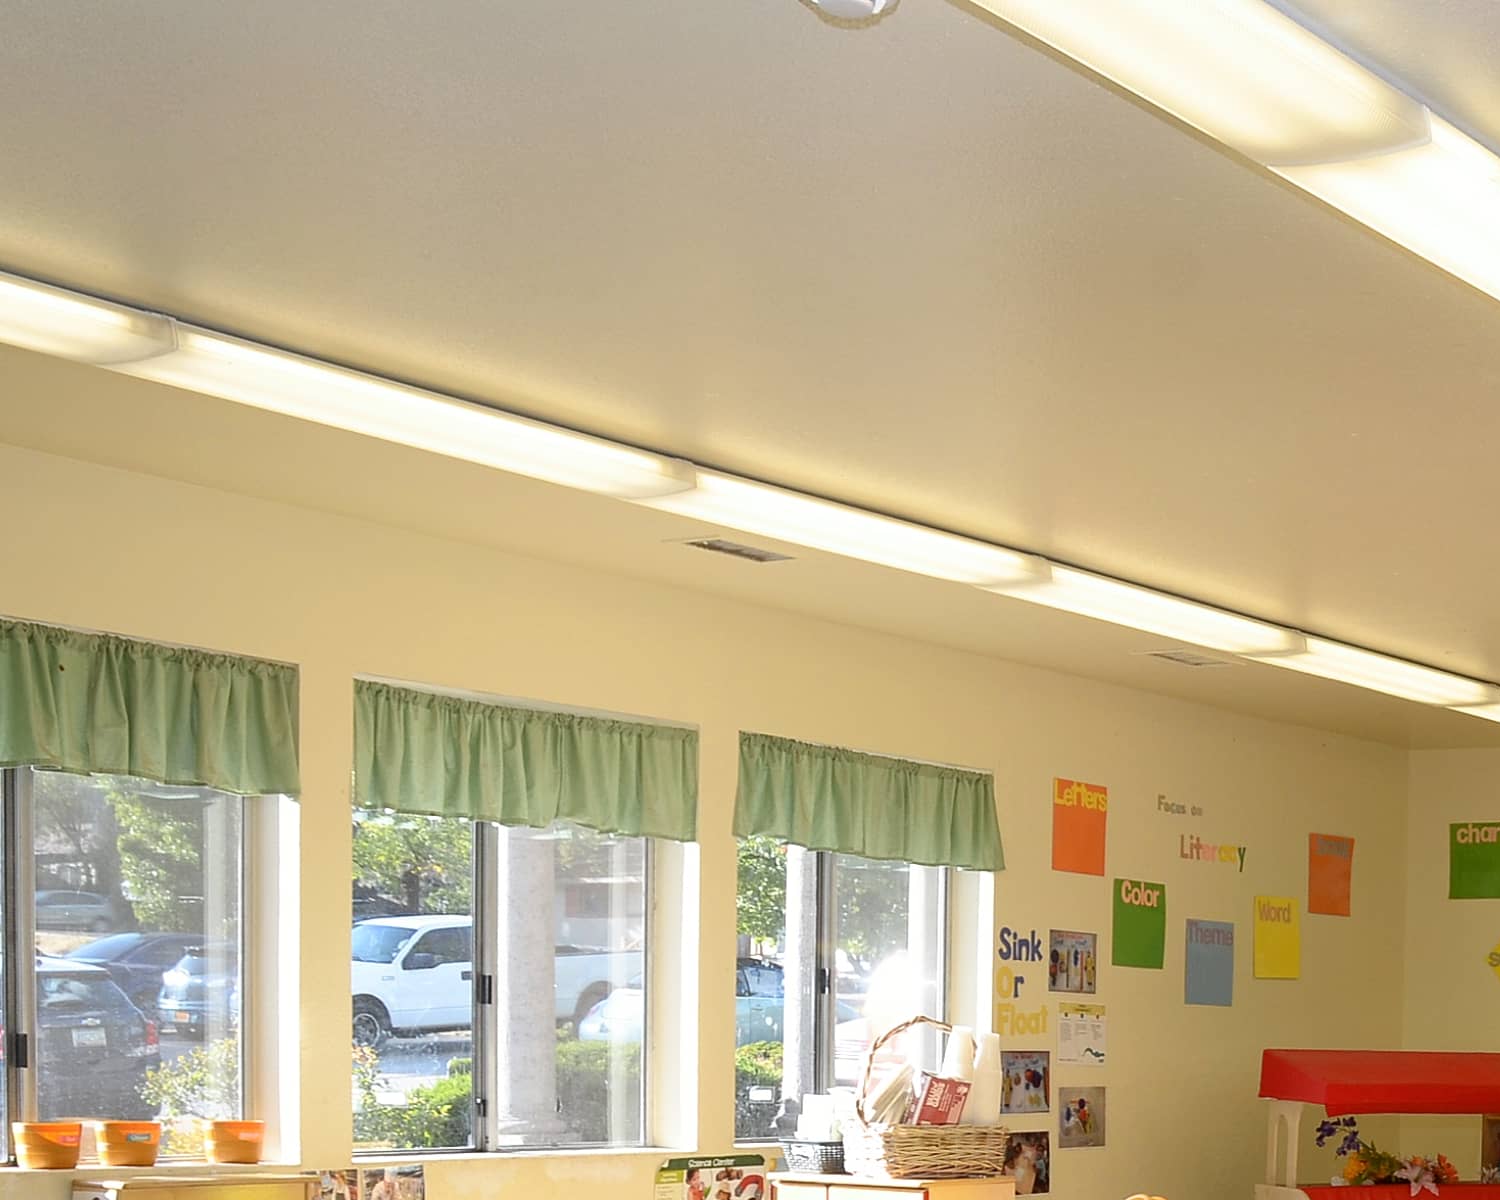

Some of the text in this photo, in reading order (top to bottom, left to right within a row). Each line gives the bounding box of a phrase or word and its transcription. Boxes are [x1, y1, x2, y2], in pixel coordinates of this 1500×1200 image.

[1055, 778, 1108, 812] Letters
[1157, 794, 1186, 815] Focus
[1180, 834, 1246, 873] Literacy
[1121, 879, 1160, 908] Color
[1258, 900, 1292, 923] Word
[998, 926, 1043, 962] Sink
[1188, 922, 1235, 947] Theme
[996, 965, 1025, 999] Or
[995, 1002, 1049, 1036] Float
